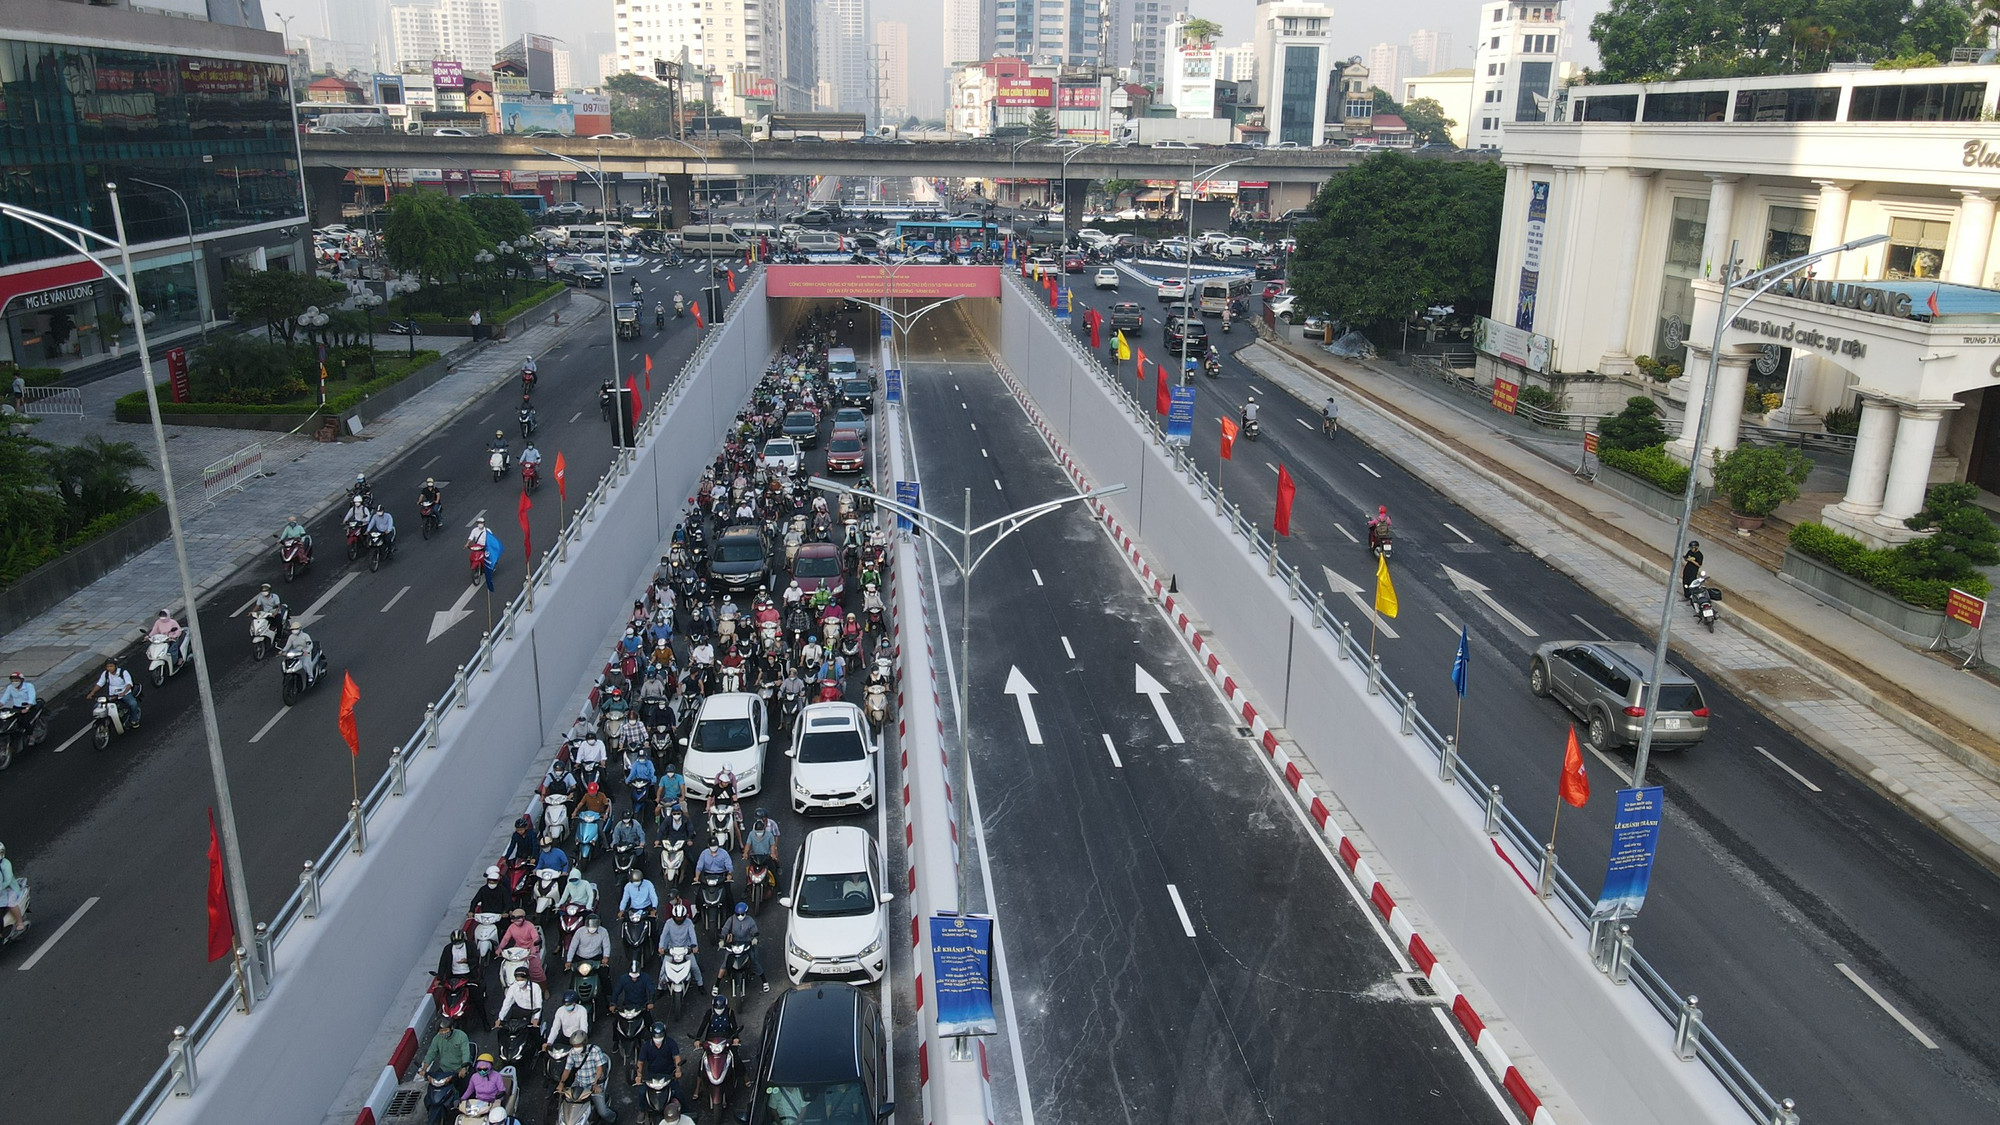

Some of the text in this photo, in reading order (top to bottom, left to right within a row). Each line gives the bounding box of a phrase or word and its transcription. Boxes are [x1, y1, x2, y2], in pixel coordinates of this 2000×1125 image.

[434, 67, 462, 75] BỆNH VIỆN
[26, 296, 39, 309] MG
[40, 292, 50, 306] LÊ
[50, 289, 67, 304] VĂN
[1835, 282, 1912, 318] LƯƠNG
[1760, 320, 1780, 338] TÂM
[1781, 321, 1796, 342] TỔ
[1795, 329, 1826, 348] CHỨC
[1826, 337, 1842, 355] SỰ
[1841, 339, 1868, 359] KIỆN
